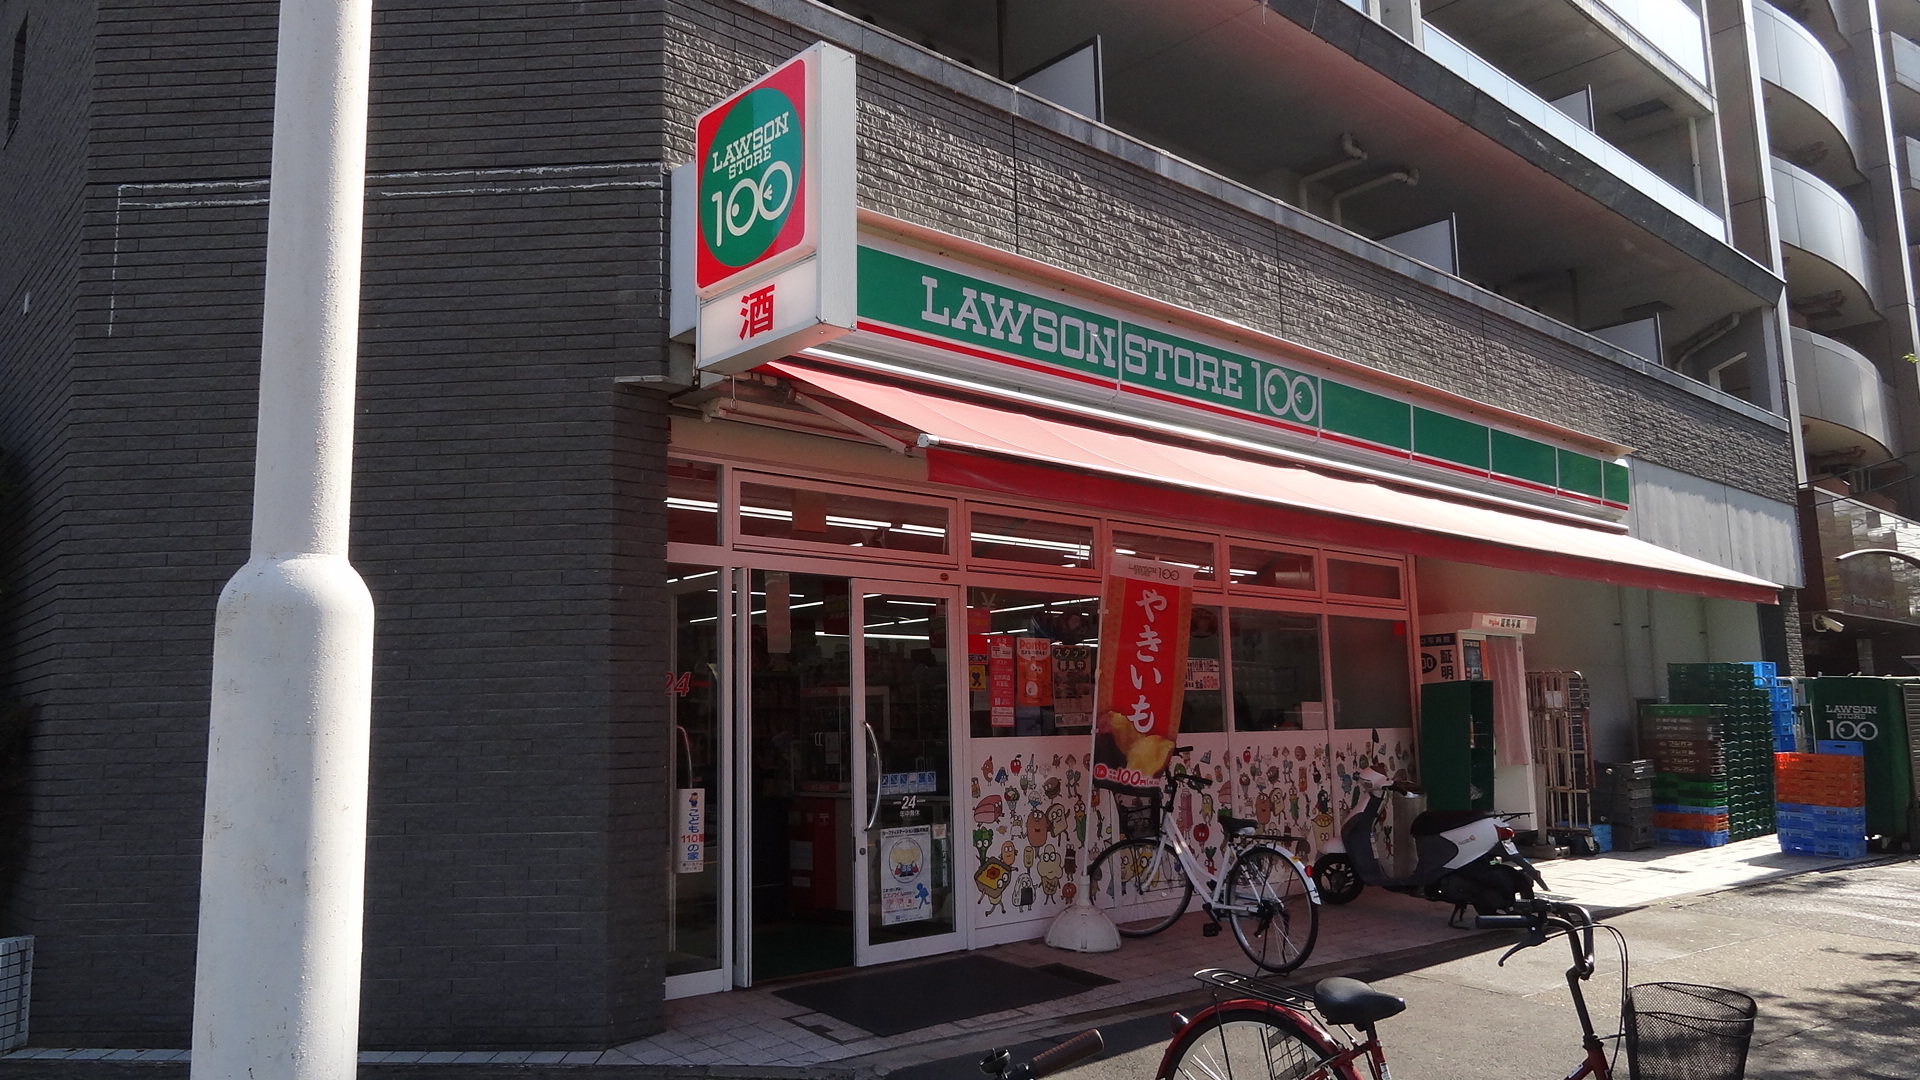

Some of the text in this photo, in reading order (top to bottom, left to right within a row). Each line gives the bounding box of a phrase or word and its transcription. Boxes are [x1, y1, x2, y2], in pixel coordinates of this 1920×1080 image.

[711, 111, 789, 174] LAWSON
[728, 144, 772, 180] STORE
[711, 160, 793, 247] 100
[738, 283, 776, 341] 酒
[921, 275, 1317, 422] LAWSON STORE 100
[1158, 567, 1180, 581] 100
[1019, 639, 1048, 650] Ponta
[1055, 648, 1088, 657] スタッフ
[1058, 660, 1084, 671] 募集中
[1127, 588, 1167, 733] やきいも
[1440, 649, 1454, 680] 証明
[664, 671, 692, 697] 24
[1825, 704, 1878, 714] LAWSON
[1836, 712, 1867, 720] STORE
[1825, 719, 1879, 741] 100
[901, 795, 917, 810] 24
[899, 810, 921, 818] 年中無休
